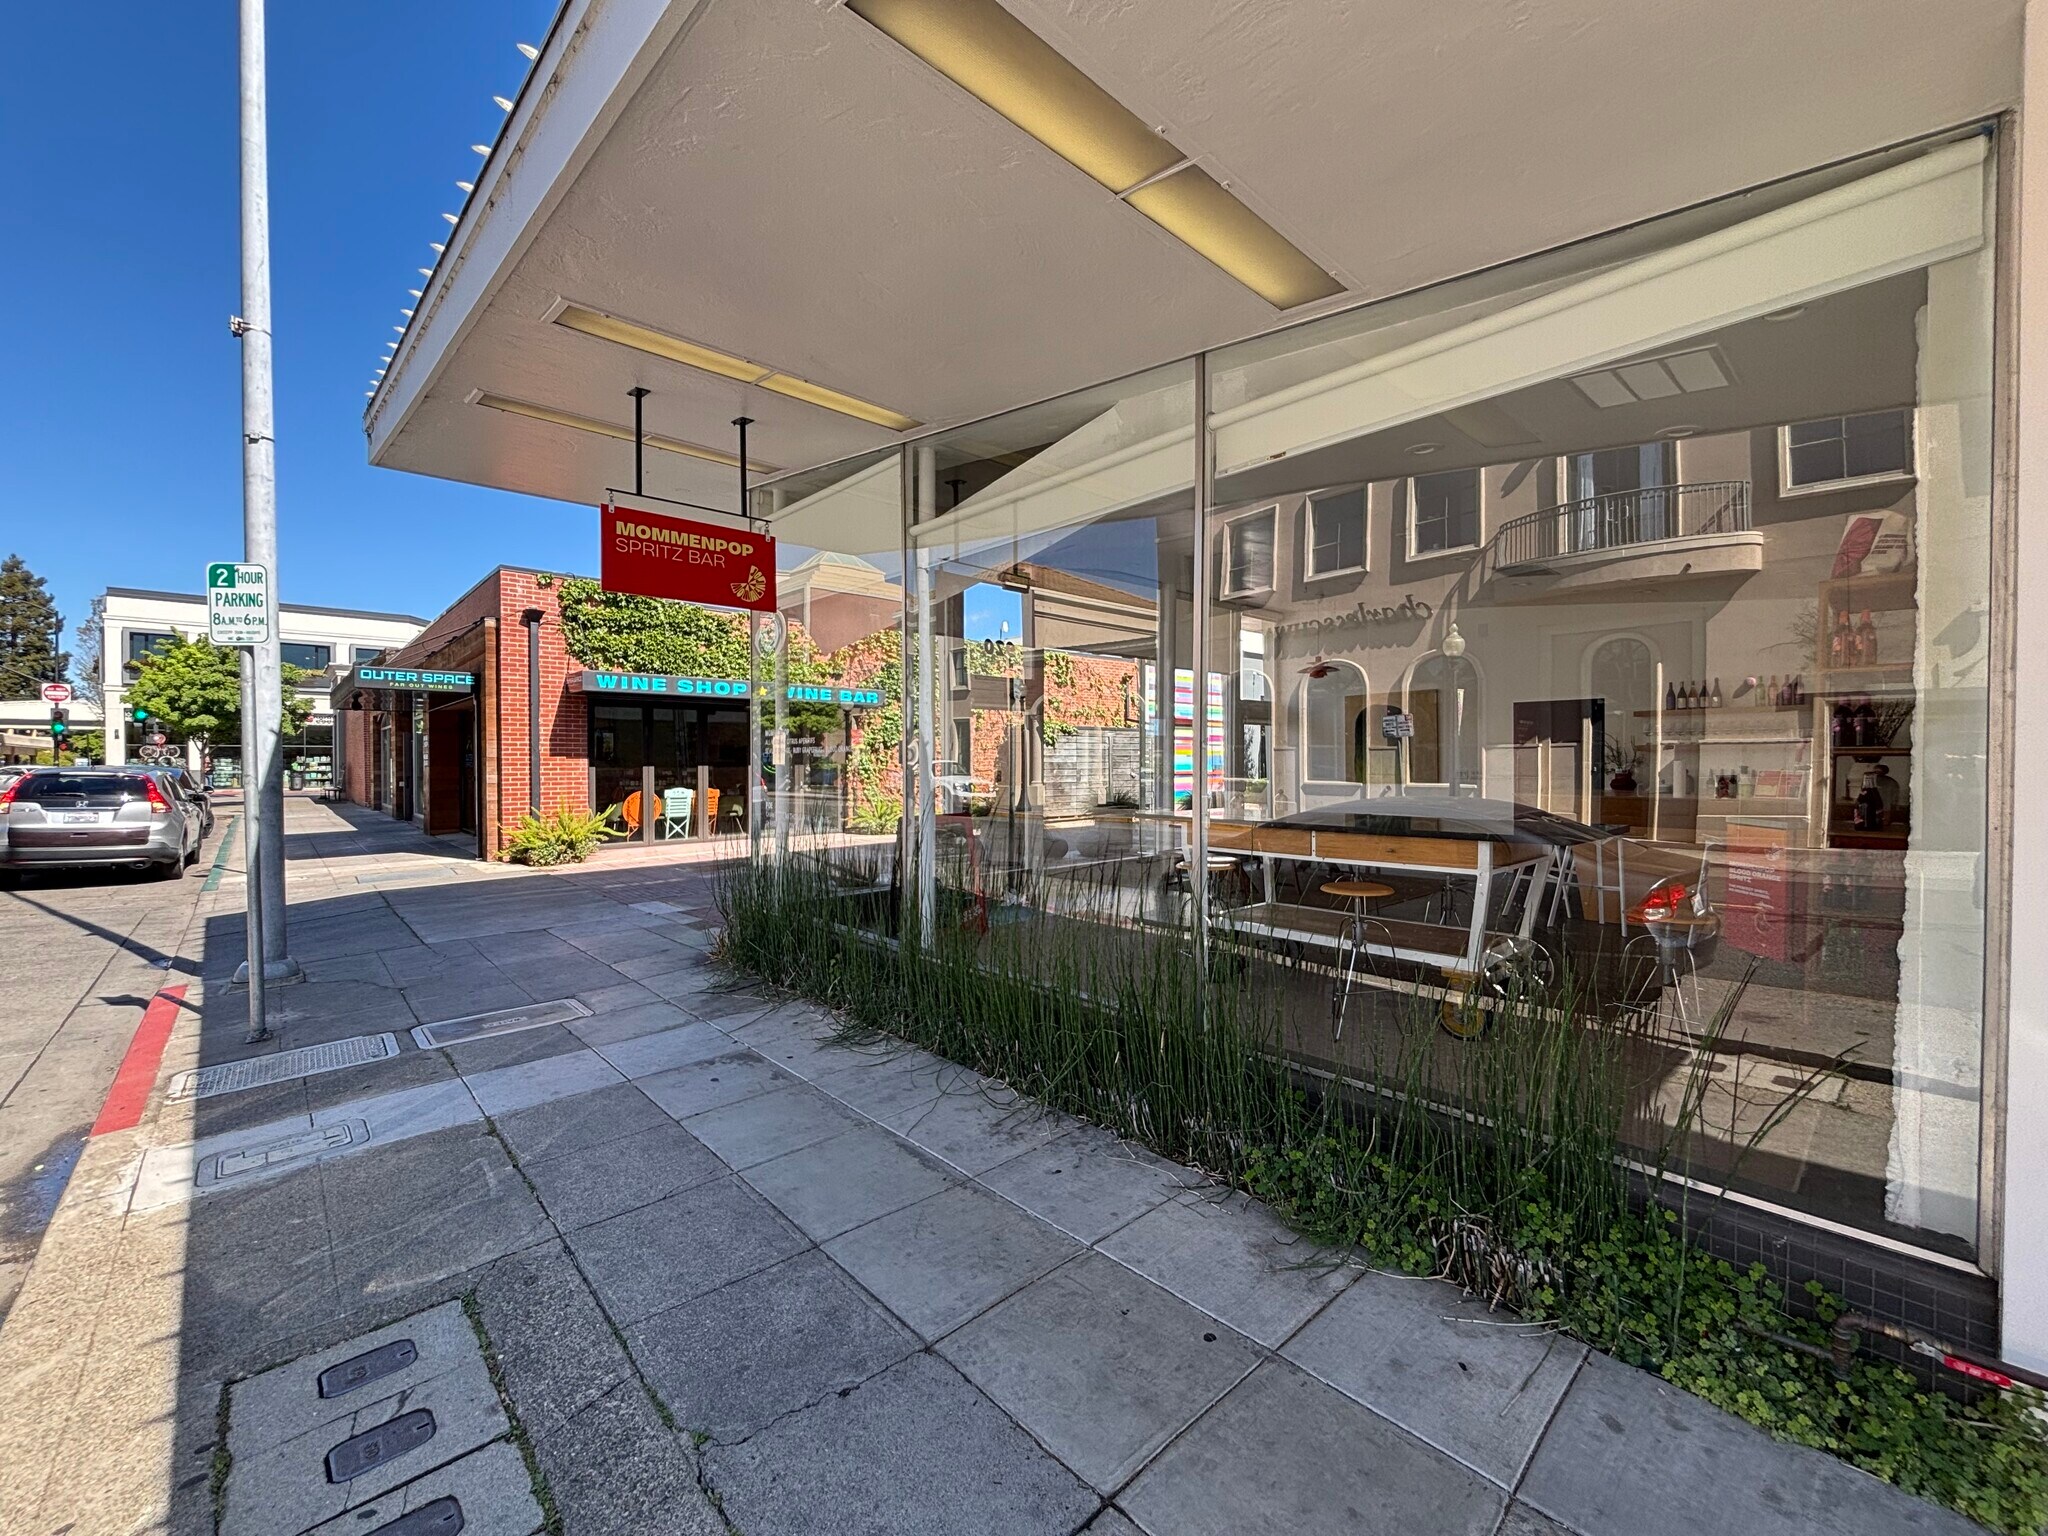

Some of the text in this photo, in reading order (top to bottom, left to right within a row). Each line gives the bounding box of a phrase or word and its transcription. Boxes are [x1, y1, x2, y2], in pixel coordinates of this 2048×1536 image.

[615, 520, 754, 557] MOMMENPOP
[615, 537, 726, 568] SPRITZ BAR
[215, 567, 264, 586] 2 HOUR
[215, 592, 264, 608] PARKING
[360, 669, 475, 685] OUTER SPACE
[597, 674, 667, 692] WINE
[676, 679, 748, 696] SHOP
[839, 689, 879, 704] BAR
[1729, 867, 1782, 882] BLOOD ORANGE
